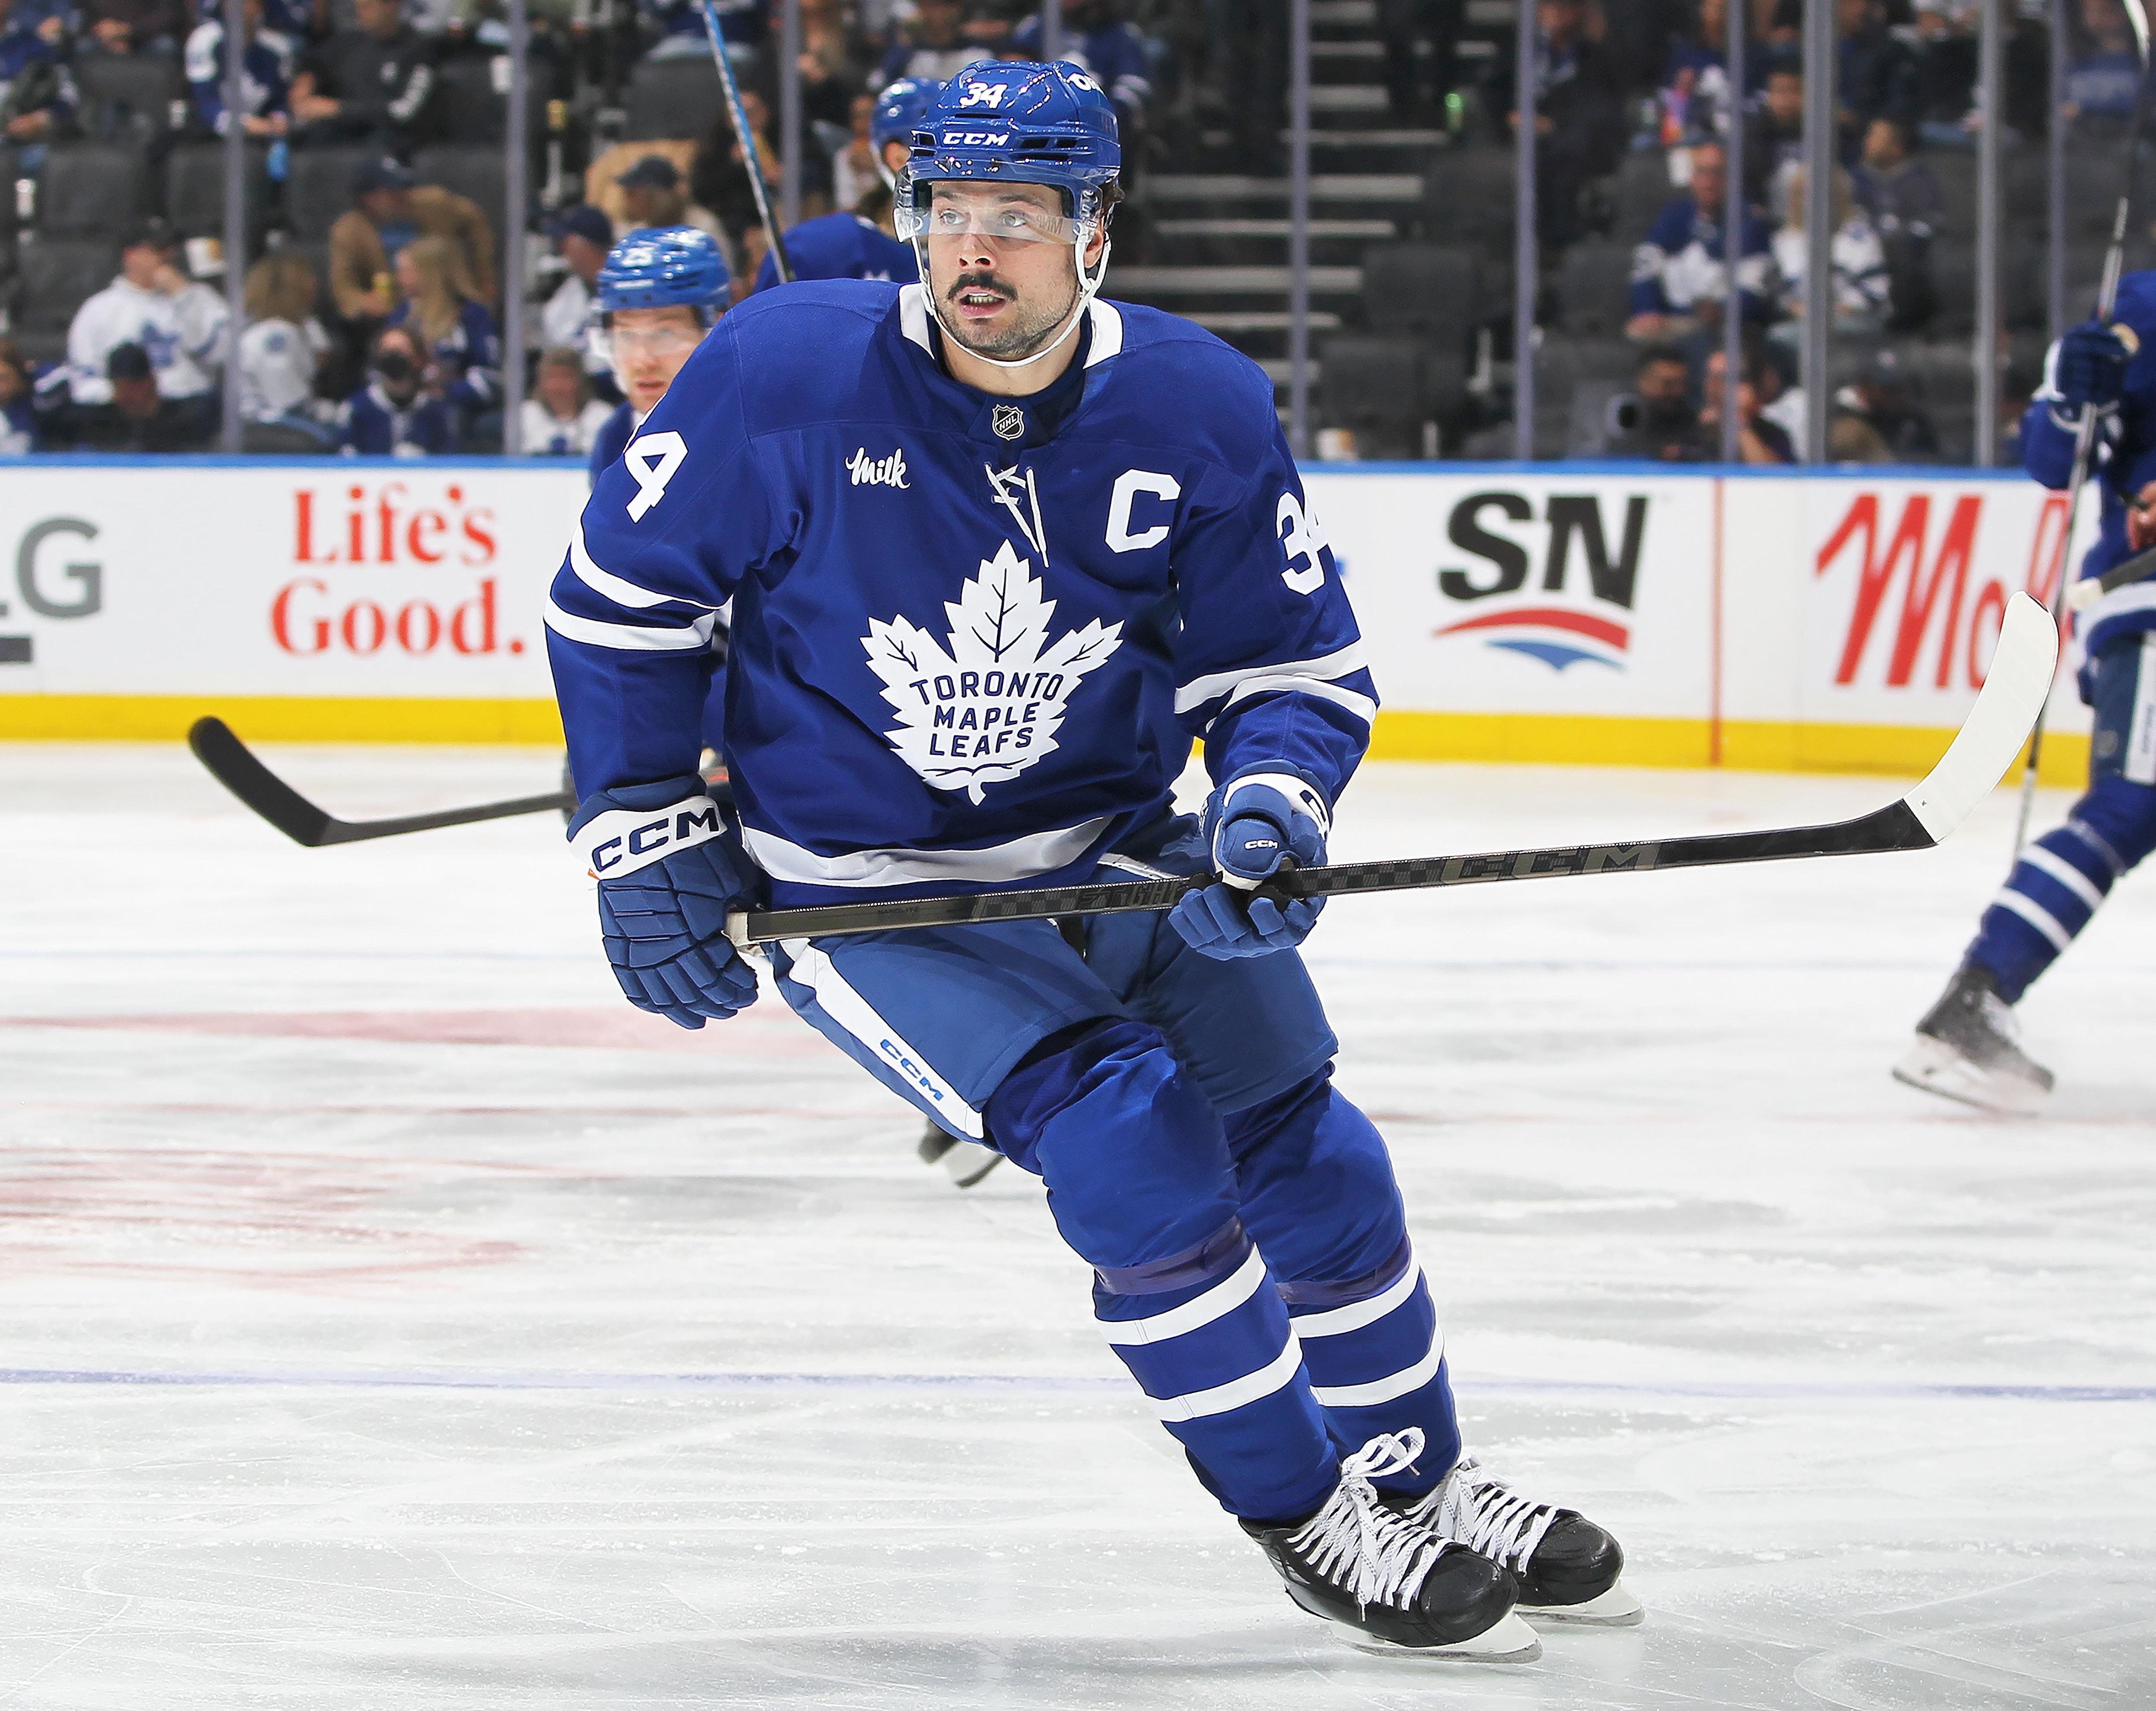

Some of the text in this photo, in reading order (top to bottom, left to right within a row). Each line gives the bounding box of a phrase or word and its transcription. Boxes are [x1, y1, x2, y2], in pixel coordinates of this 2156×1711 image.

[959, 82, 1008, 109] 34
[943, 132, 1009, 147] CCM
[999, 415, 1017, 431] NHL
[845, 447, 911, 489] Milk
[290, 482, 498, 566] Life's
[1105, 468, 1182, 554] C
[0, 516, 103, 620] G
[1438, 491, 1650, 610] SN
[270, 577, 527, 657] Good.
[909, 671, 1064, 705] TORONTO
[934, 701, 1040, 731] MAPLE
[929, 727, 1034, 758] LEAFS
[592, 807, 720, 873] CCM
[1244, 840, 1278, 850] CCM
[1440, 844, 1662, 884] CCM
[880, 1038, 944, 1101] CCM
